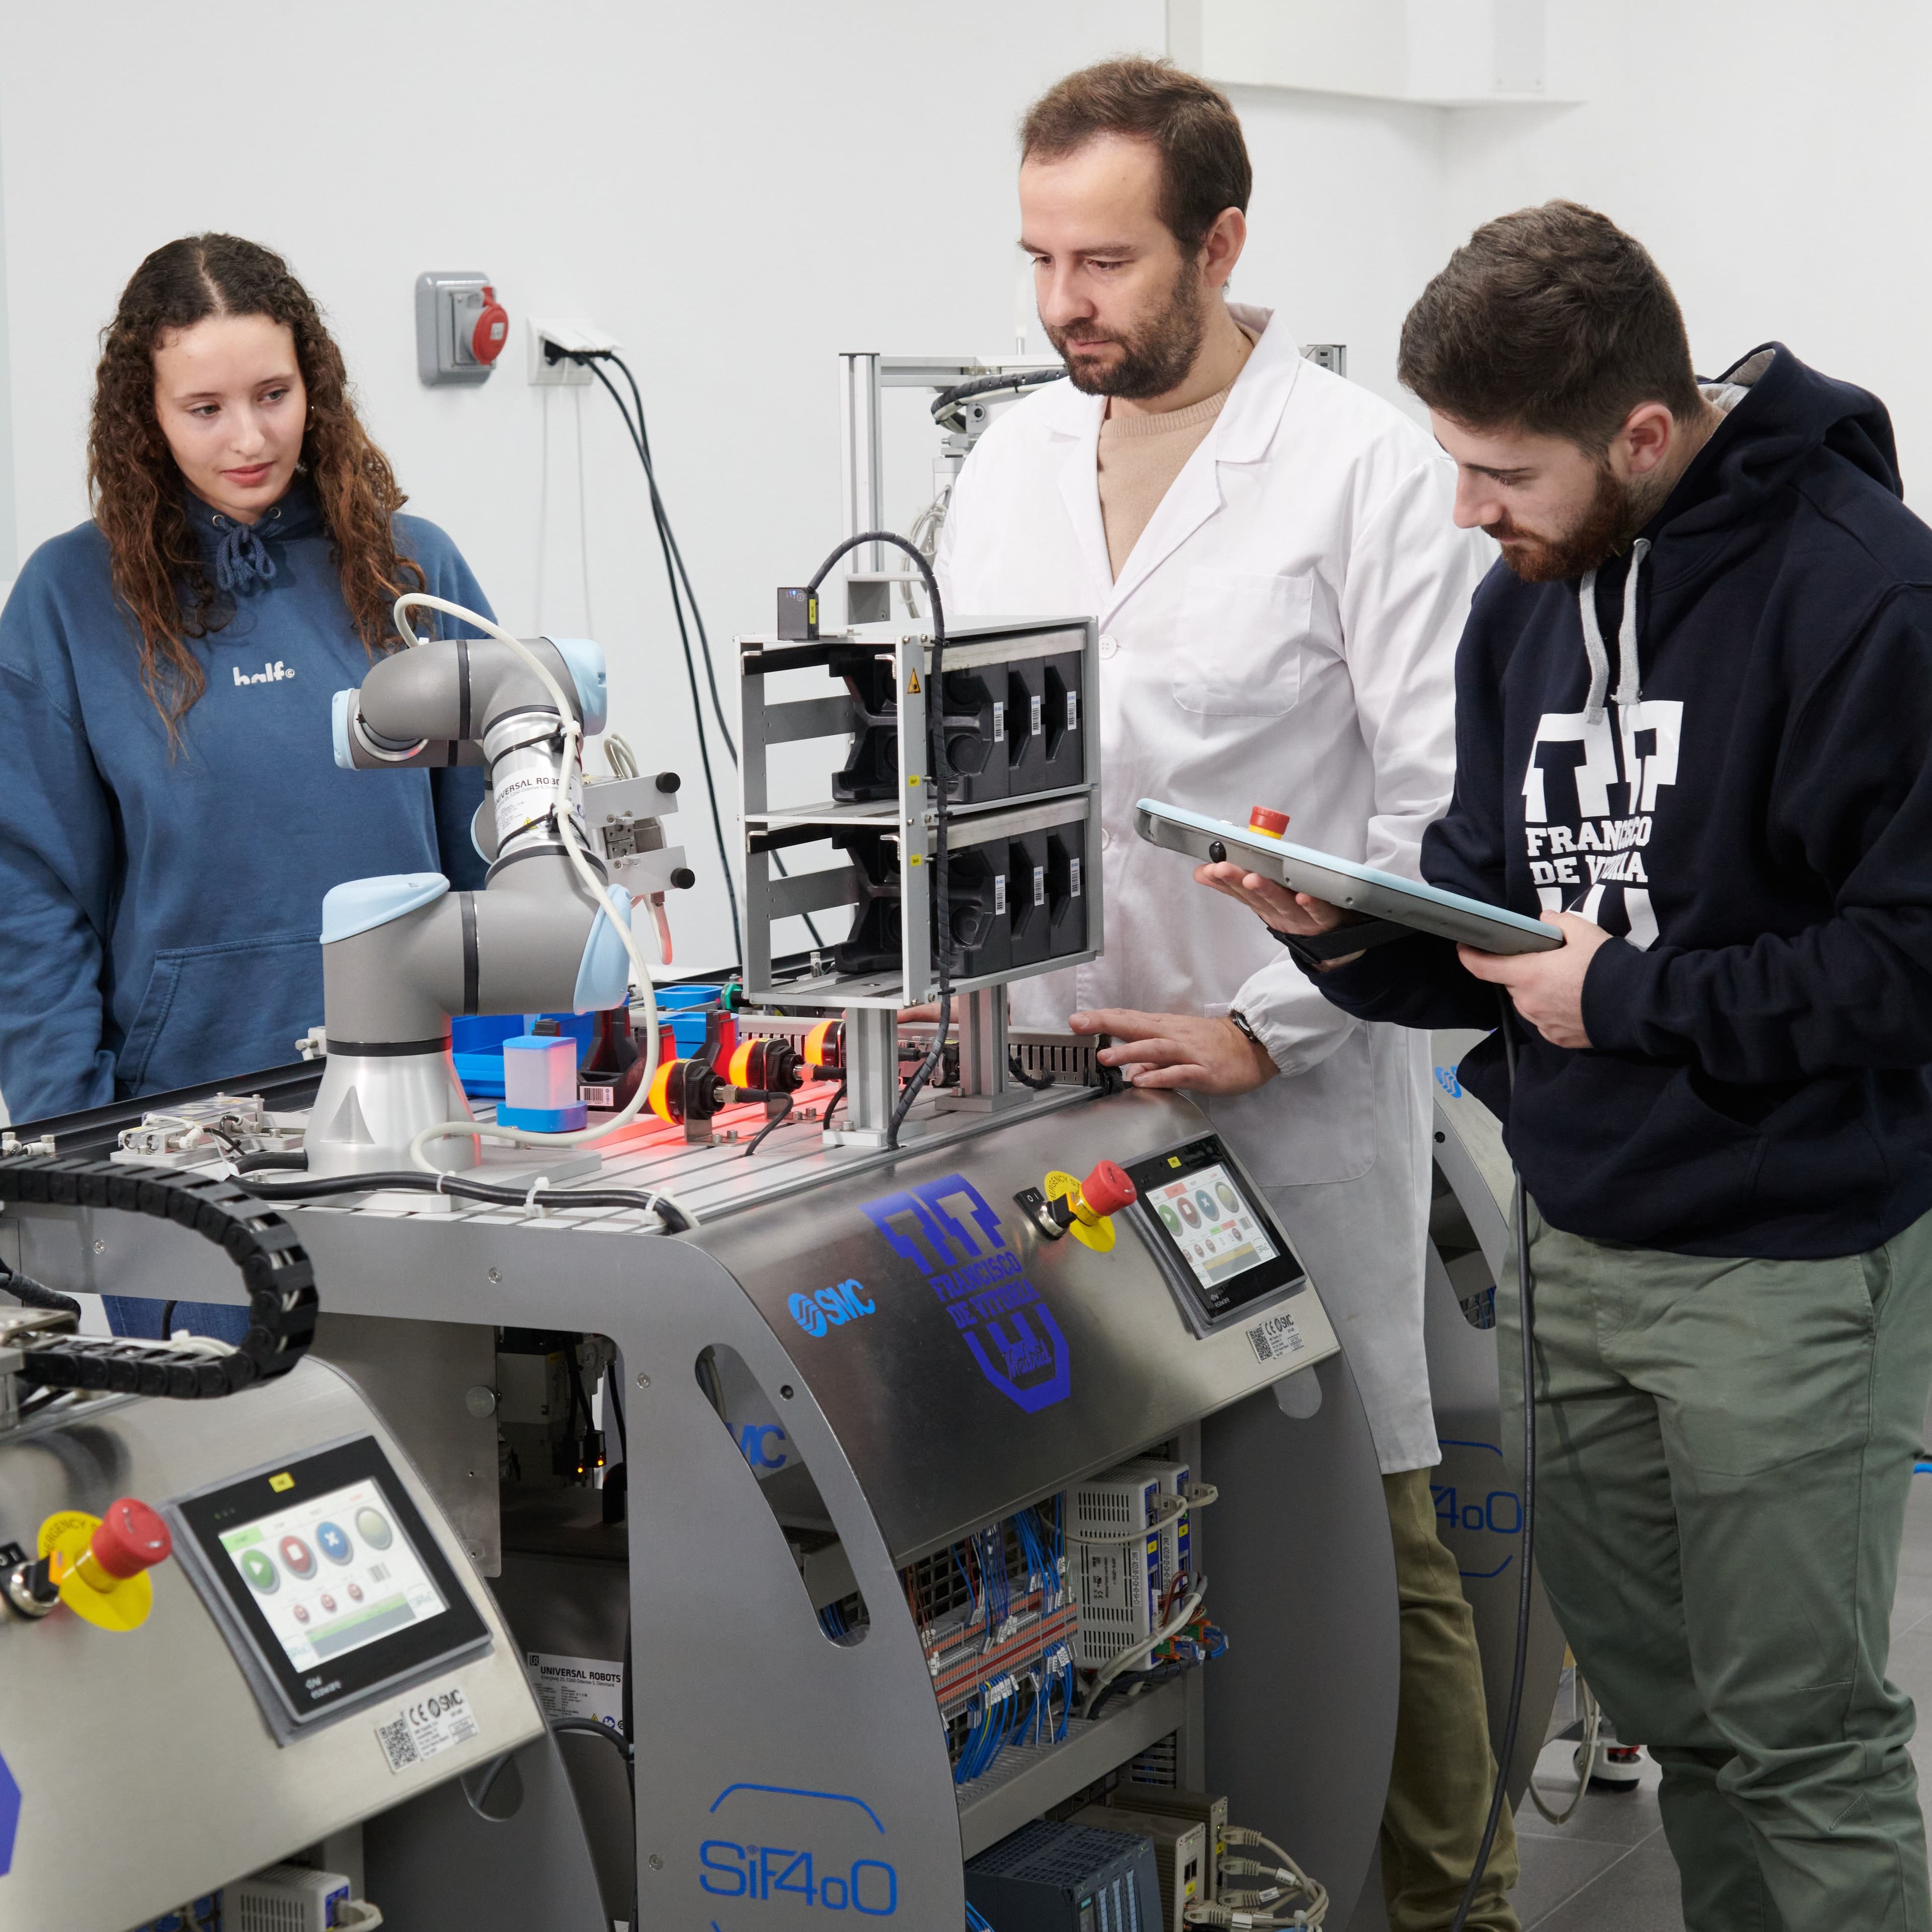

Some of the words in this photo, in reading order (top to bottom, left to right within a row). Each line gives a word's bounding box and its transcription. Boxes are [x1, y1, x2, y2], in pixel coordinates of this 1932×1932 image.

[1530, 856, 1580, 885] DE
[1048, 1175, 1069, 1201] MERGENCY
[928, 1250, 1023, 1302] FRANCISCO
[814, 1278, 876, 1326] SMC
[946, 1301, 978, 1330] DE
[969, 1278, 1041, 1319] VITORIA
[540, 1666, 587, 1679] UNIVERSAL
[589, 1671, 621, 1683] ROBOTS
